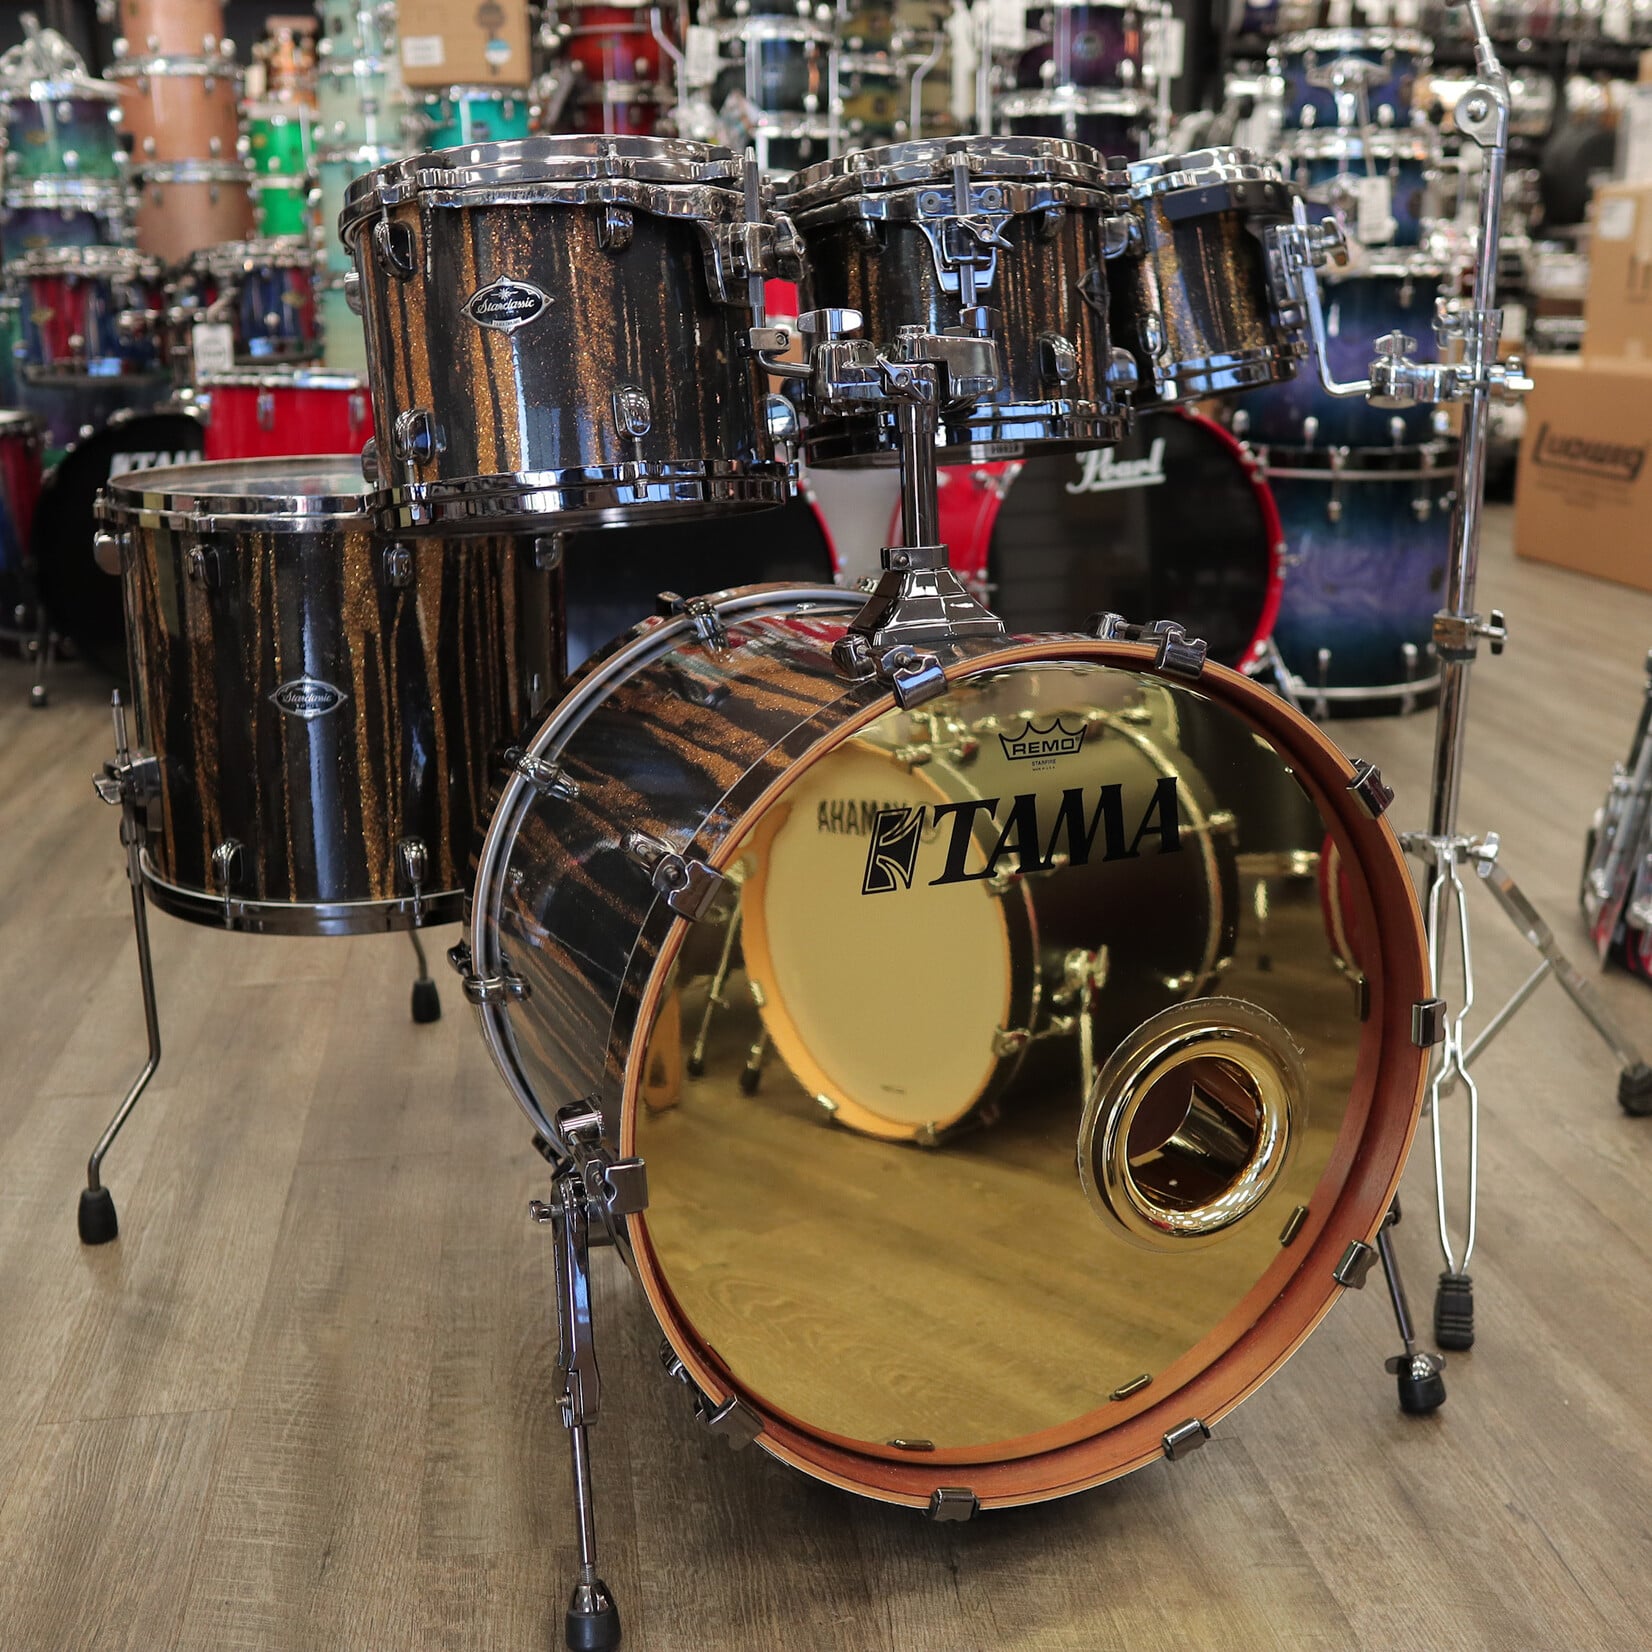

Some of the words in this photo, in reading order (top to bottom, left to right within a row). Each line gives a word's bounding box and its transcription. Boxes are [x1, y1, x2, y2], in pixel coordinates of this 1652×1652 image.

[476, 297, 535, 314] Starclassic
[1012, 738, 1075, 755] REMO
[928, 777, 1182, 886] TAMA
